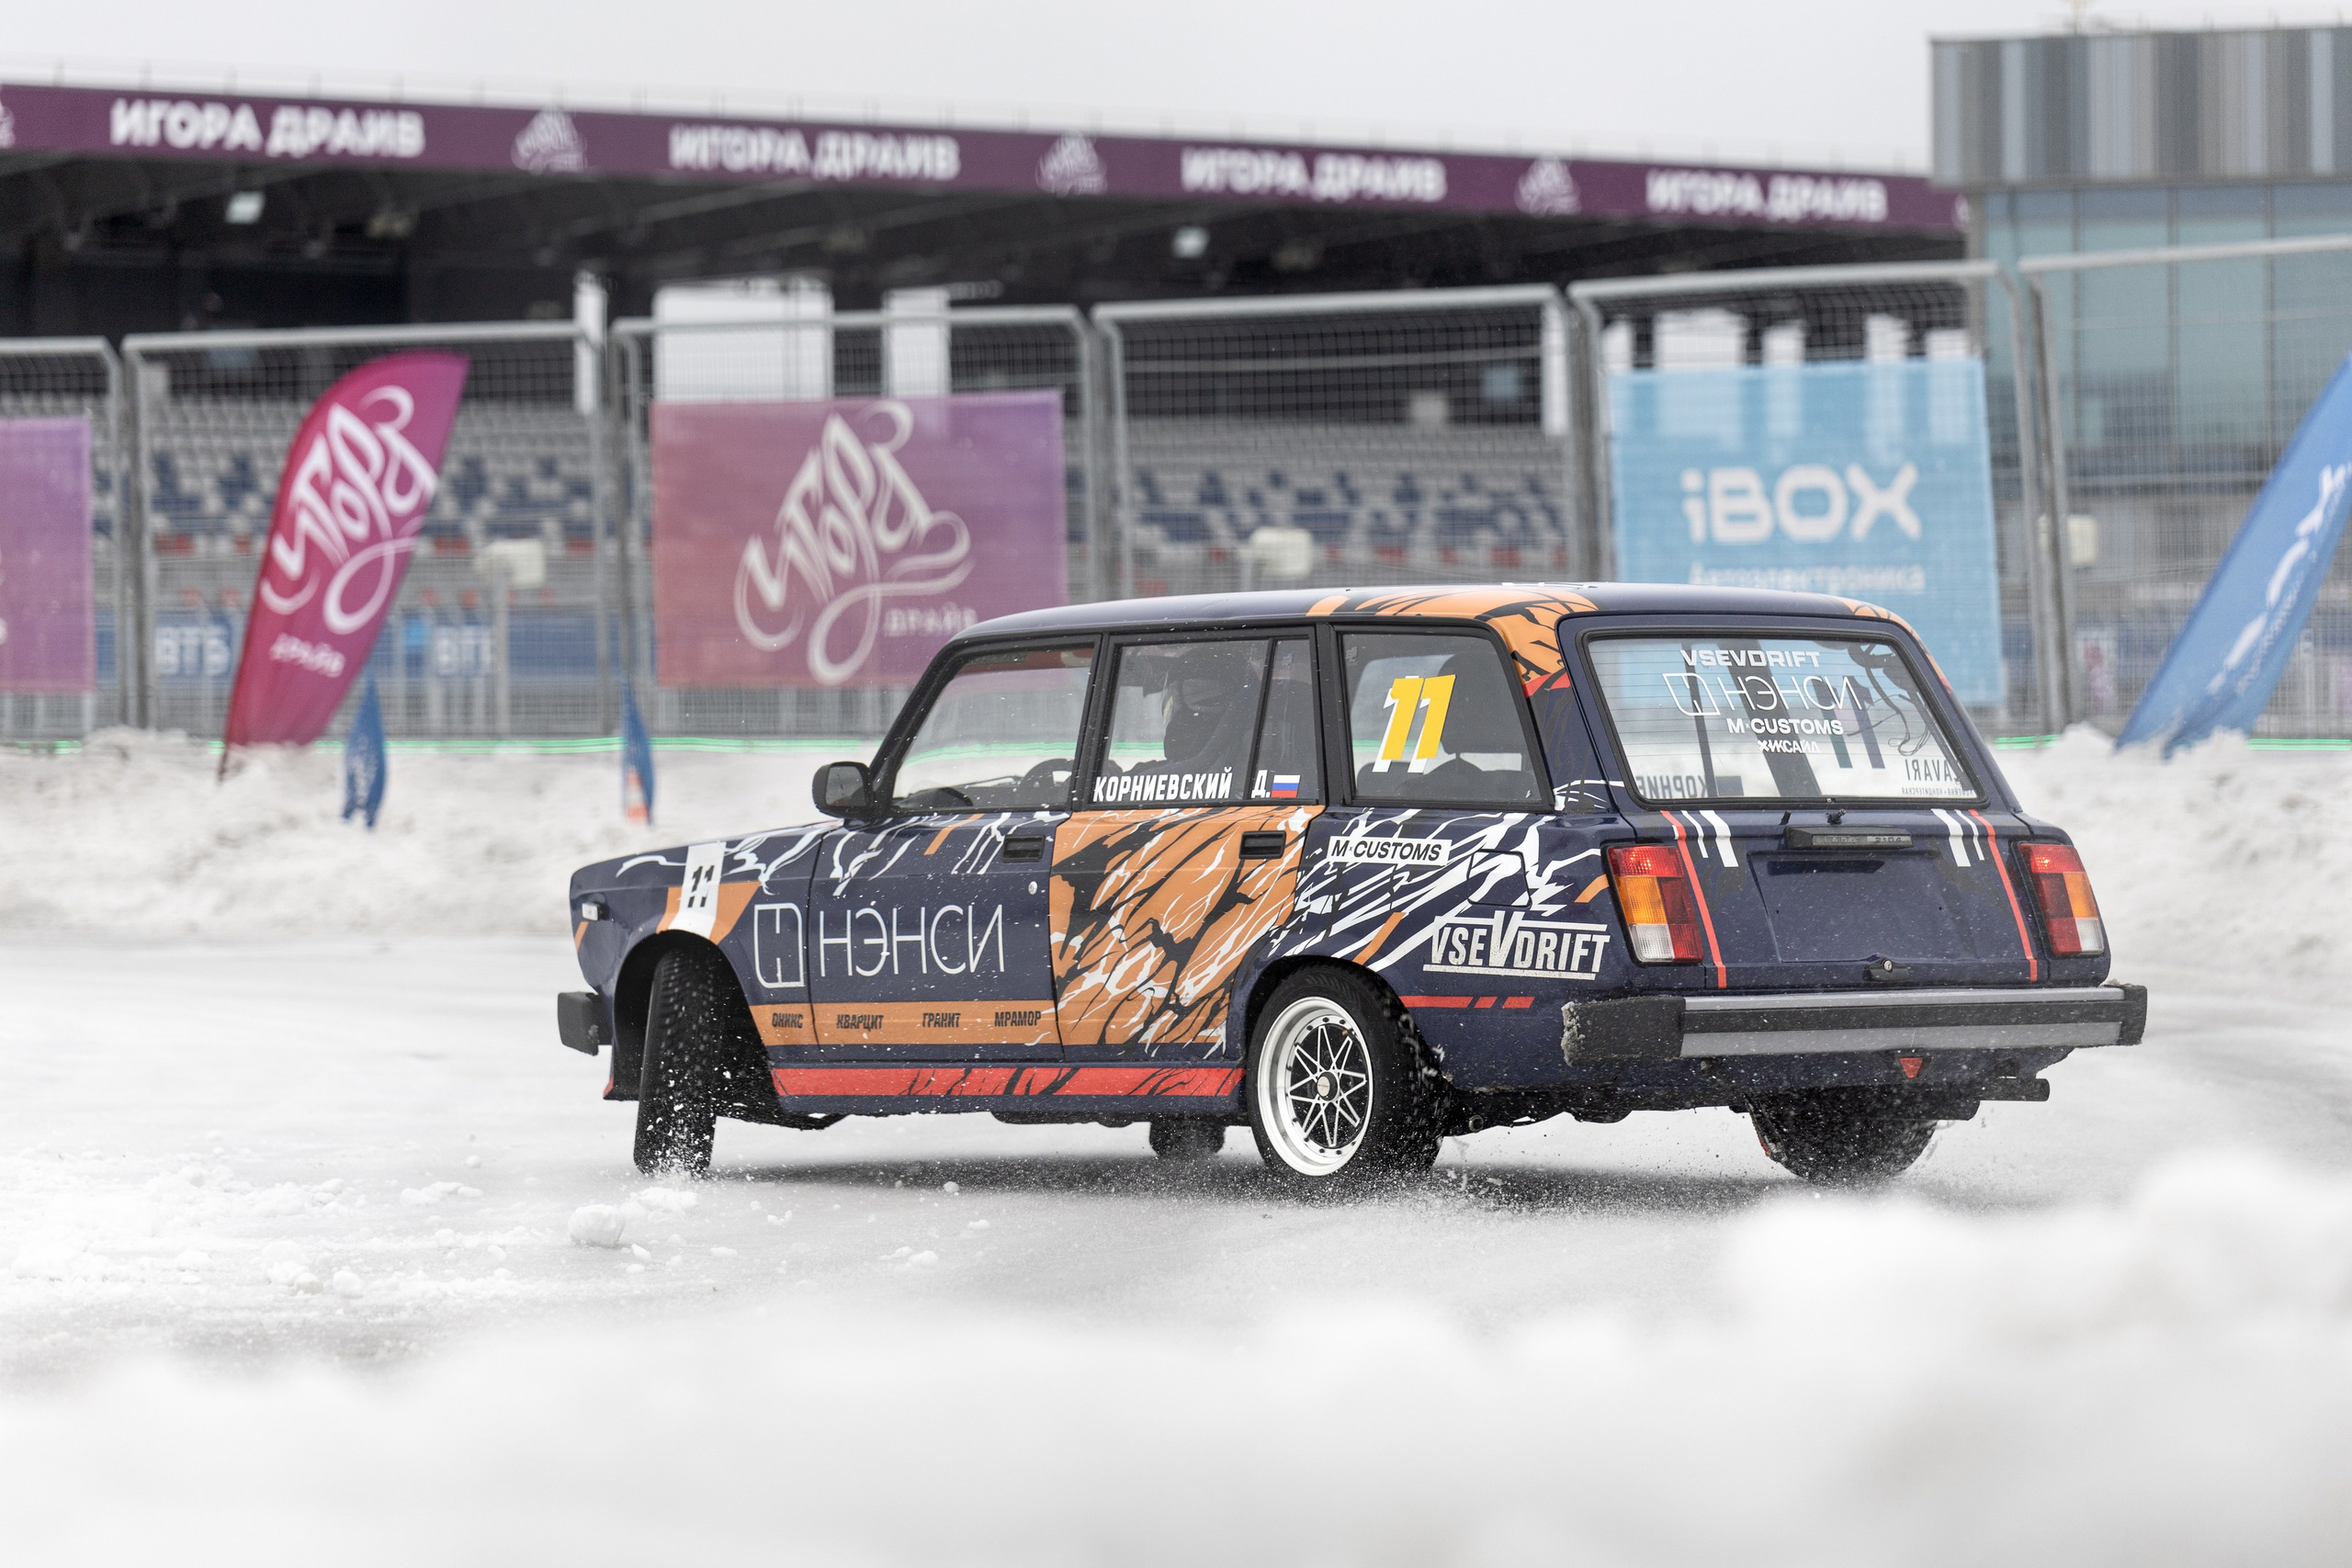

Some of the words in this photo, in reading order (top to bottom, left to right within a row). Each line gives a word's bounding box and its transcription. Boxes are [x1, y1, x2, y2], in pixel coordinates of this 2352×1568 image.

[110, 97, 264, 151] ИГОРА
[669, 123, 811, 175] ИГОРА
[1679, 463, 1922, 546] iBOX
[1680, 649, 1820, 668] VSEVDRIFT
[1717, 675, 1862, 711] НЭНСИ
[1372, 674, 1456, 773] 11
[1093, 767, 1232, 802] КОРНИЕВСКИЙ
[819, 904, 1005, 976] НЭНСИ
[1430, 910, 1611, 973] VSEVDRIFT
[772, 1012, 804, 1029] ОНИКС
[836, 1013, 884, 1032] КВАРЦИТ
[922, 1012, 961, 1028] ГРАНИТ
[994, 1010, 1042, 1027] МРАМОР
